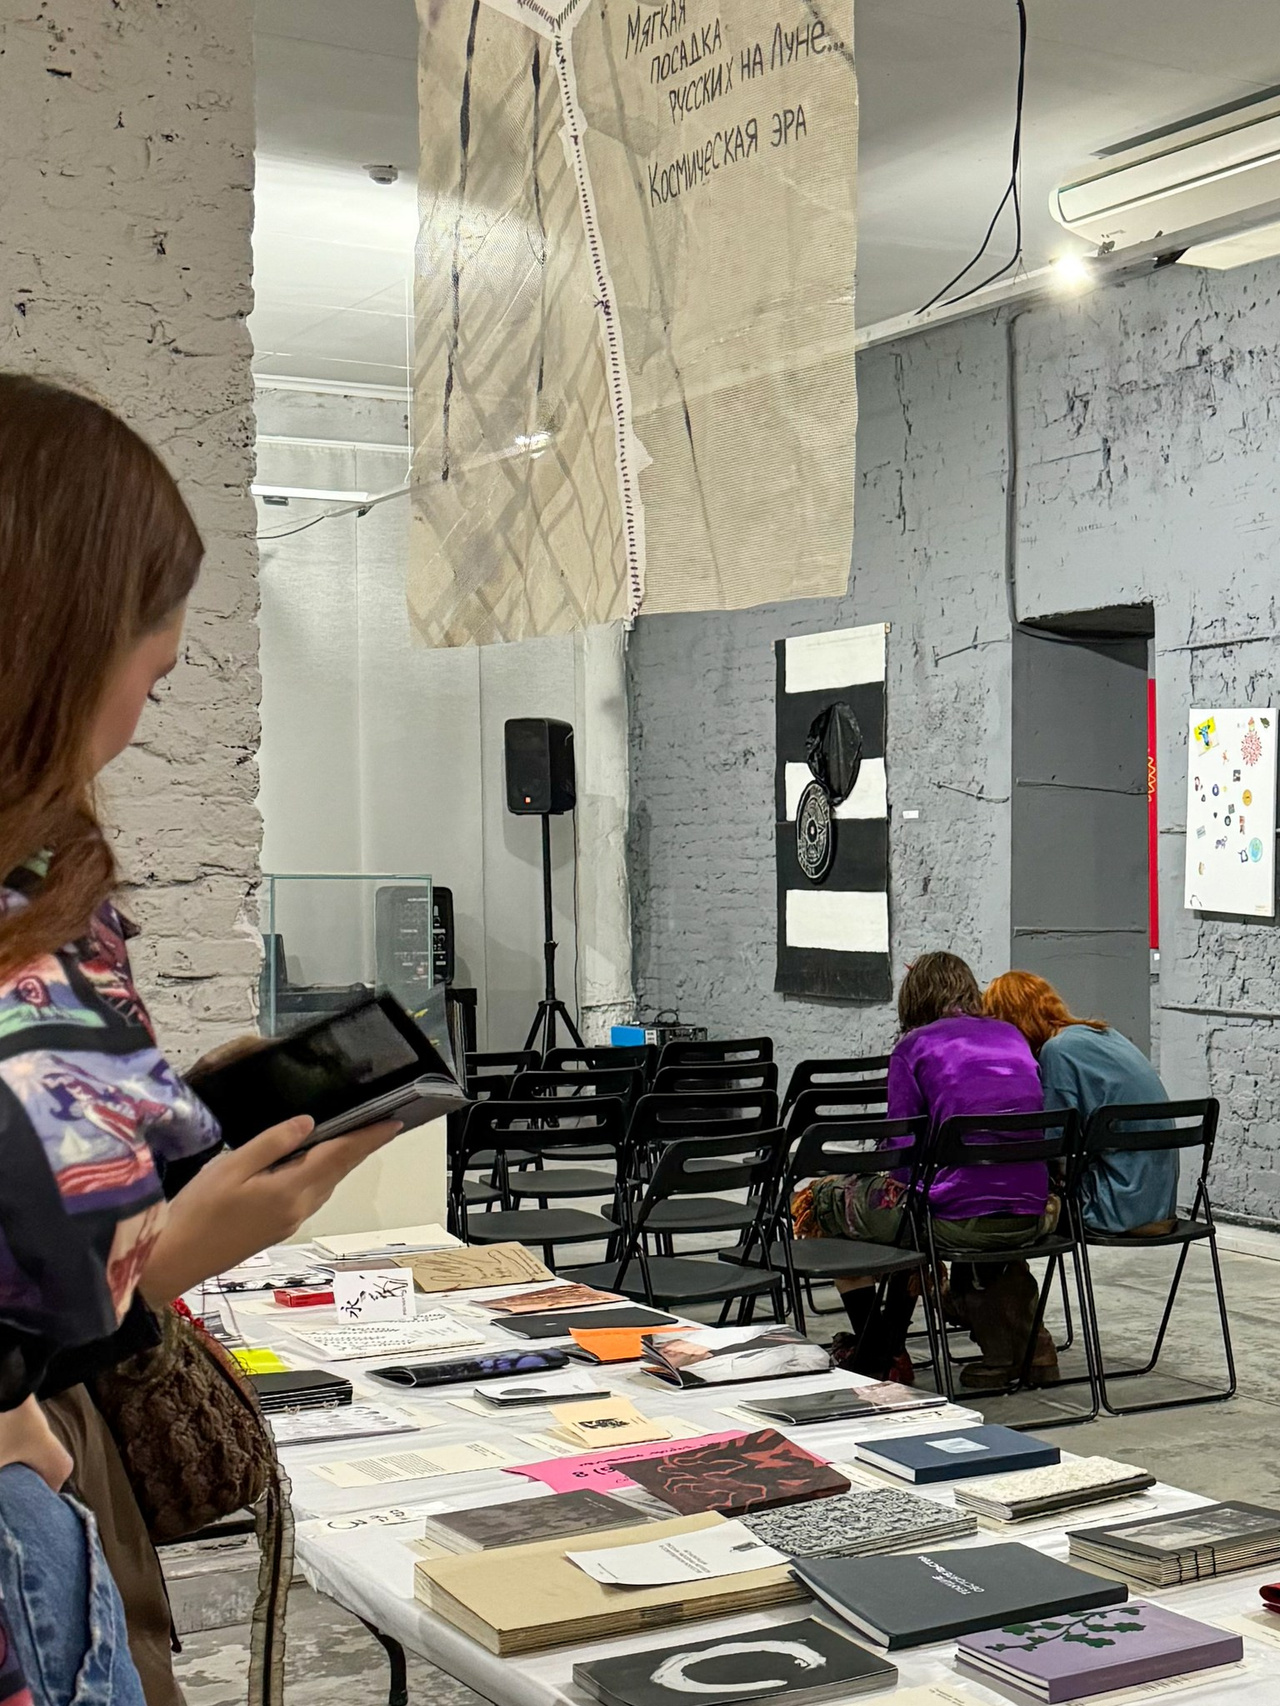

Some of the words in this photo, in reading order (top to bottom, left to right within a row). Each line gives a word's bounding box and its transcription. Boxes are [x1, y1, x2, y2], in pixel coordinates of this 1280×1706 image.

[650, 17, 722, 84] ПОСАДКА
[669, 56, 734, 125] РУССКИХ
[740, 43, 764, 82] НА
[771, 104, 807, 147] ЭРА
